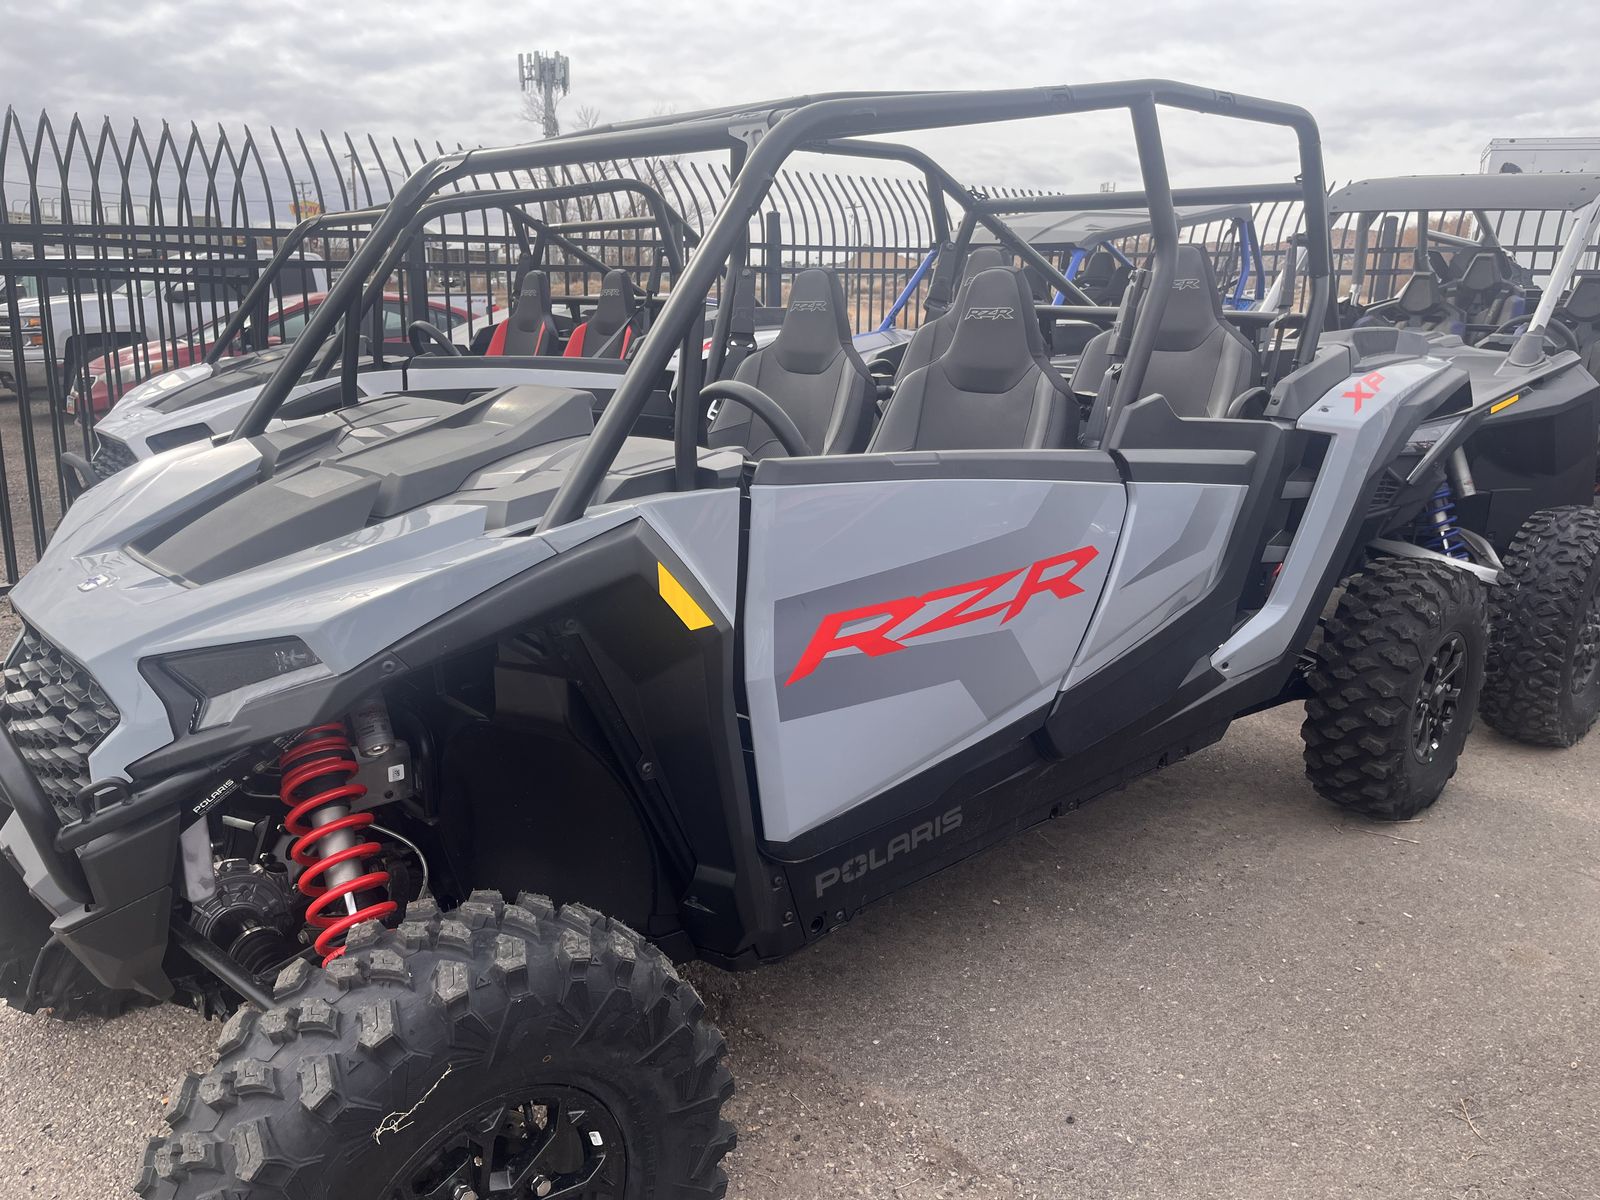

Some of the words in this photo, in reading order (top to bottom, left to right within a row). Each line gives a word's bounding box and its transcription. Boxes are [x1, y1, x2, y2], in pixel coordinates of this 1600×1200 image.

[790, 300, 828, 312] RZR
[964, 306, 1015, 321] RZR
[1342, 370, 1387, 416] XP
[784, 545, 1099, 688] RZR
[192, 779, 234, 814] POLARIS
[815, 805, 964, 899] POLARIS
